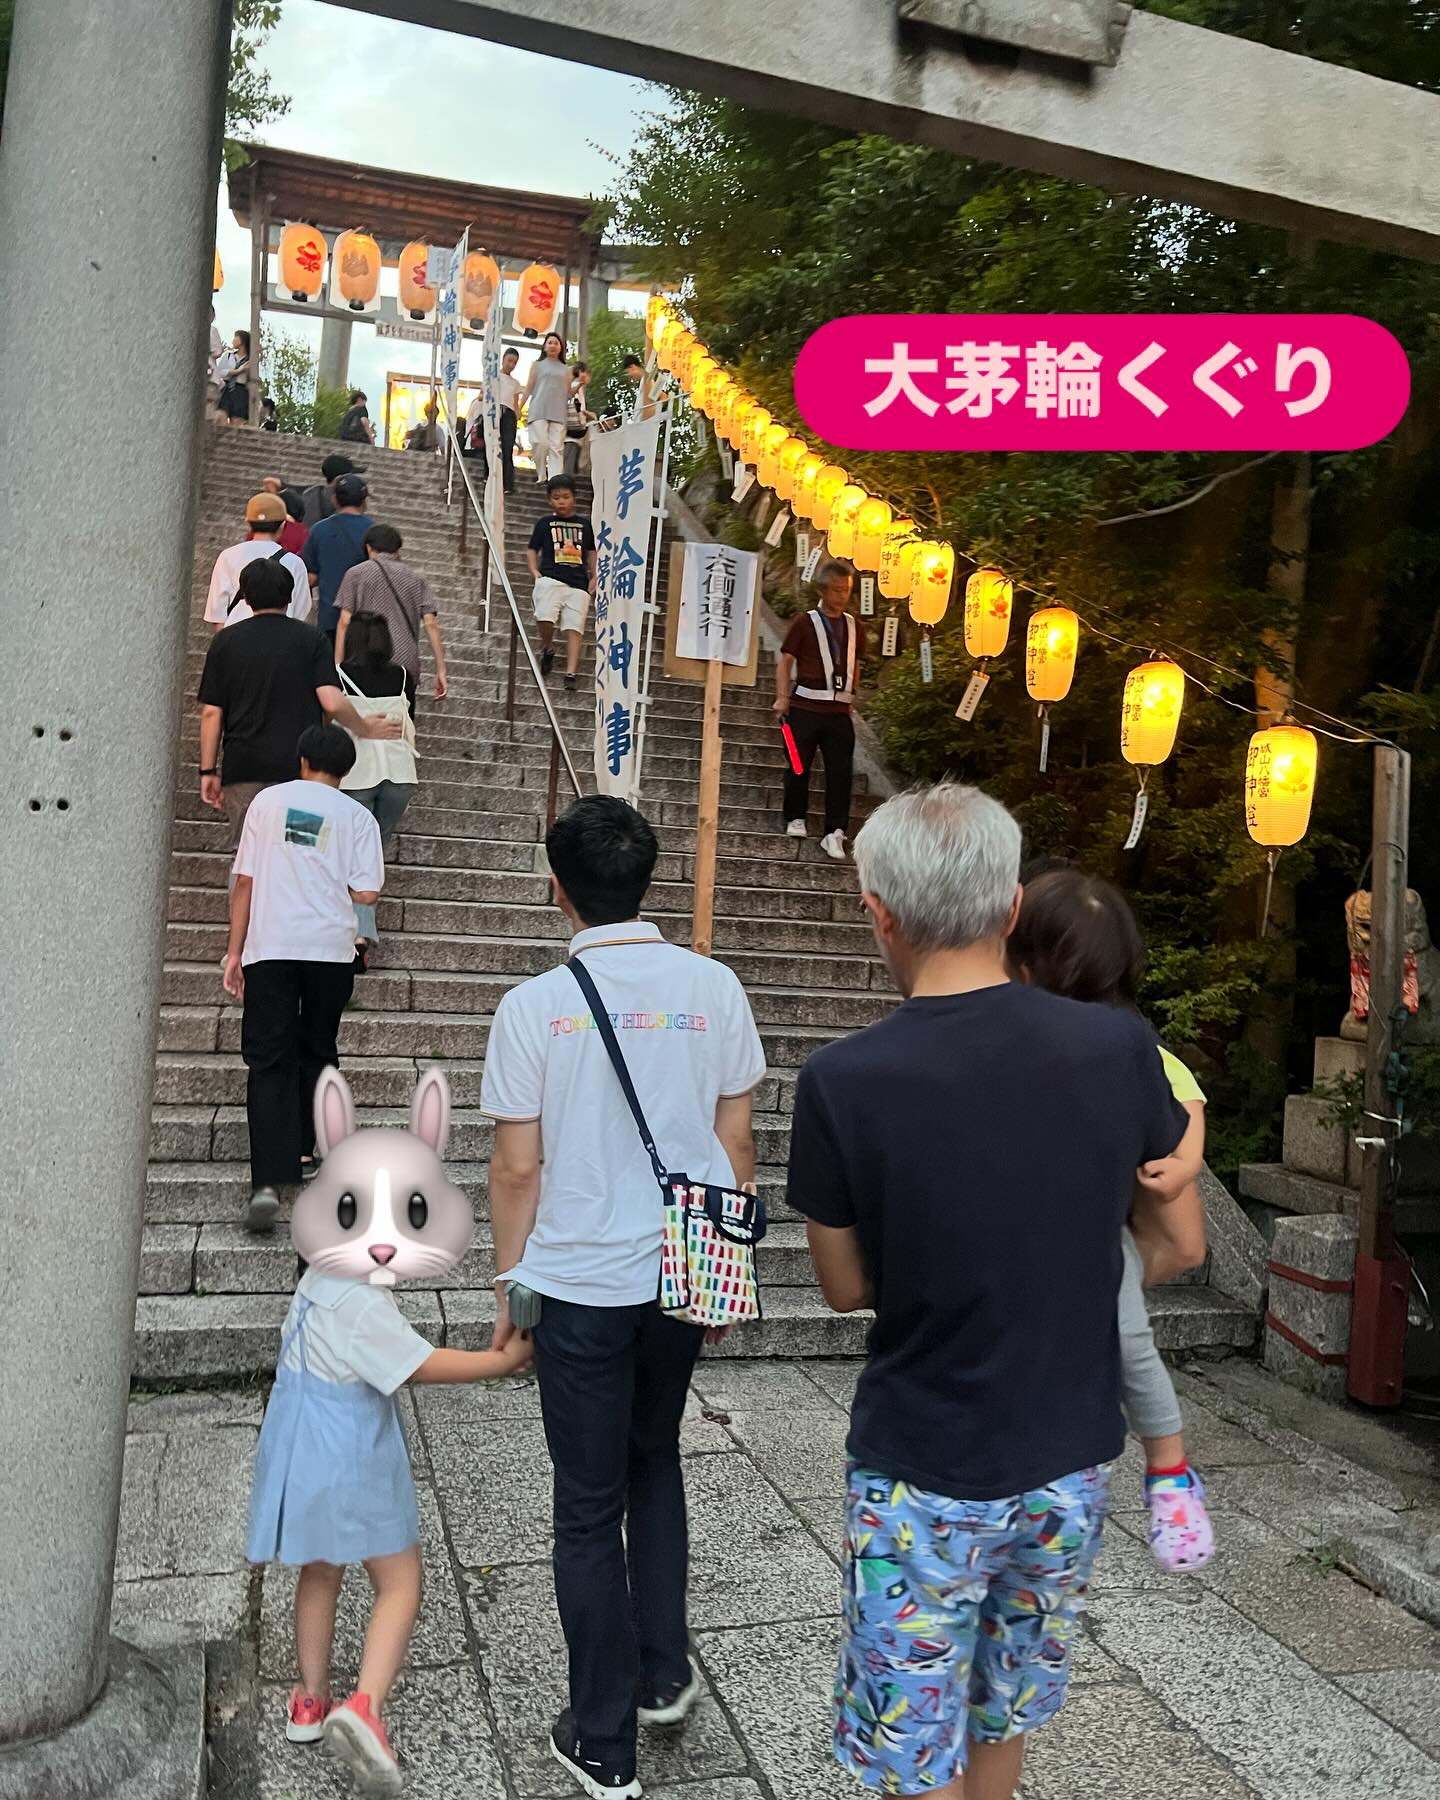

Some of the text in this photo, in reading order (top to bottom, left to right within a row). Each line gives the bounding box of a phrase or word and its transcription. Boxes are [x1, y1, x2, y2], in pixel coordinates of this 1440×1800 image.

[606, 447, 646, 776] 茅輪神事
[699, 552, 738, 639] 左側通行
[622, 1013, 706, 1032] HILFIGER
